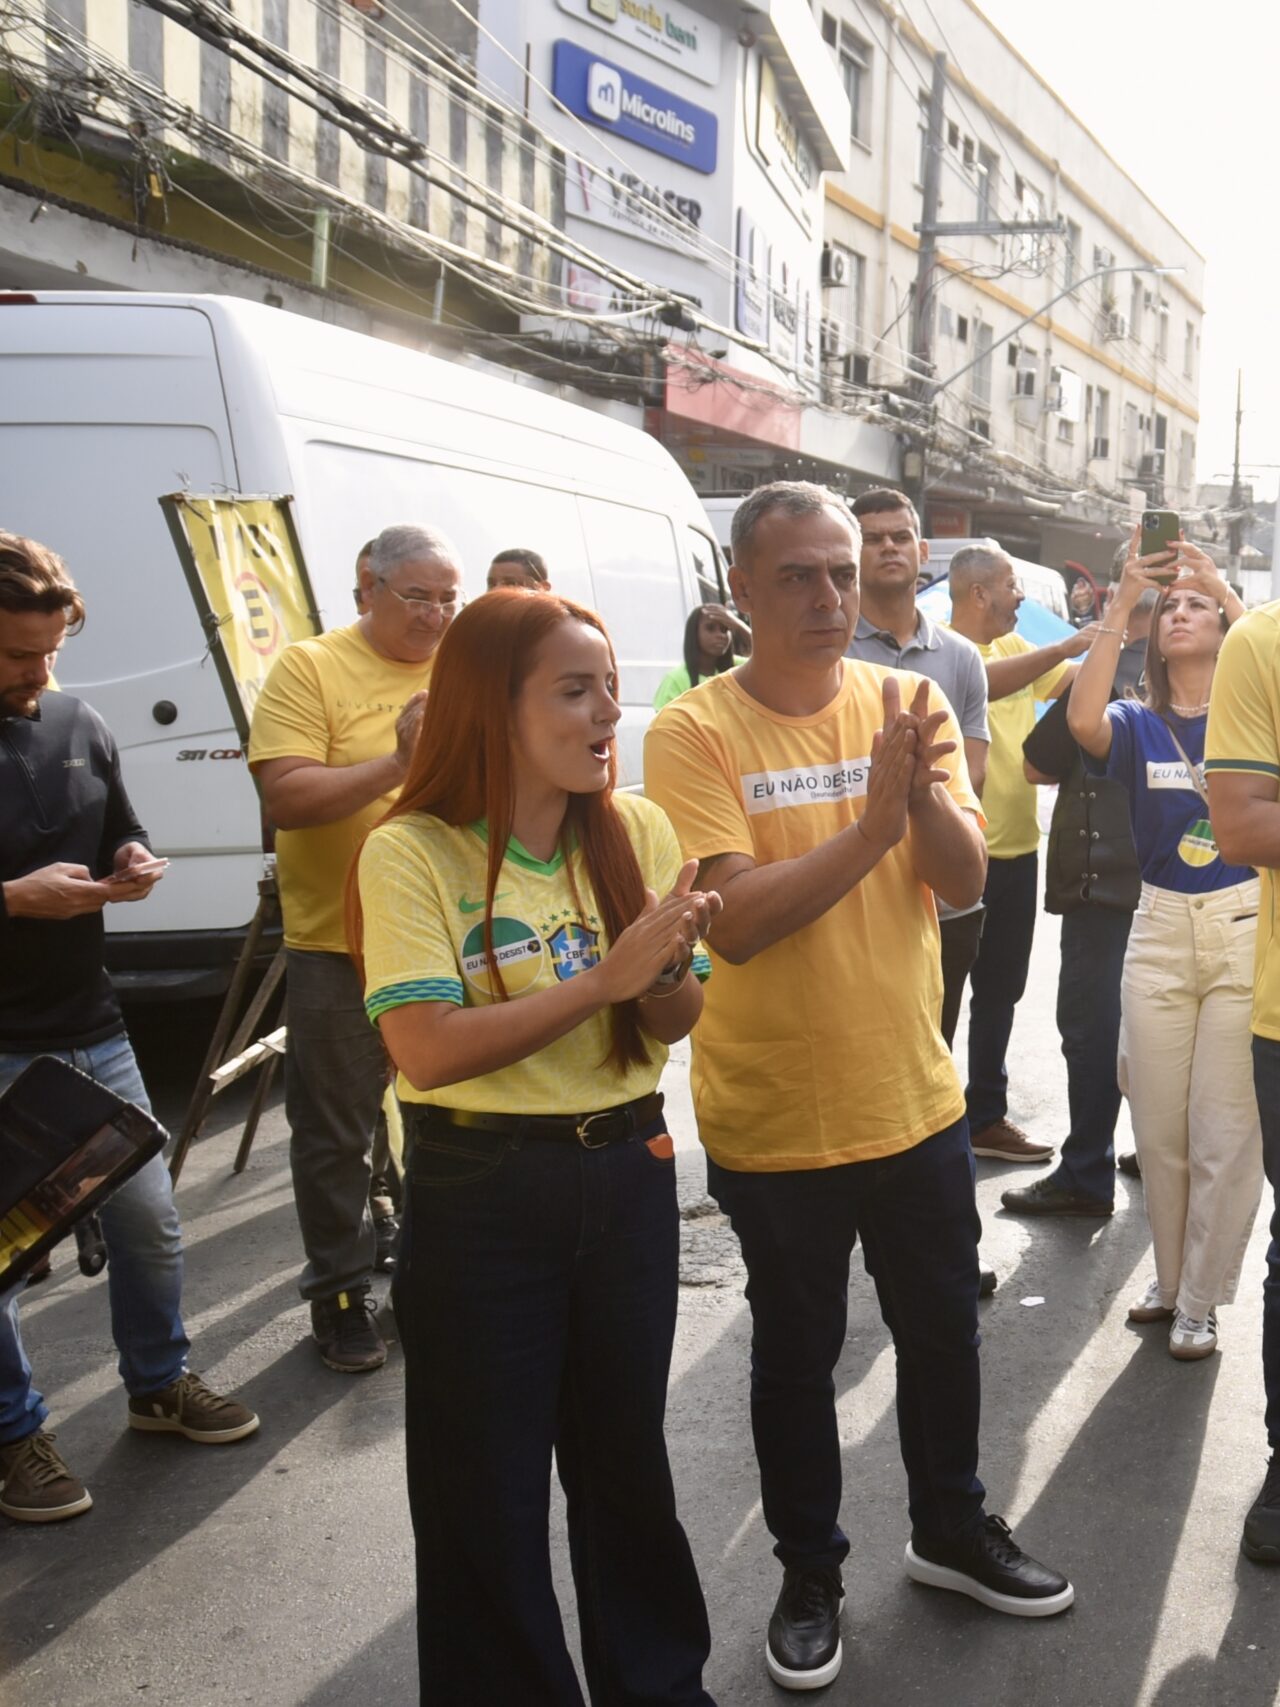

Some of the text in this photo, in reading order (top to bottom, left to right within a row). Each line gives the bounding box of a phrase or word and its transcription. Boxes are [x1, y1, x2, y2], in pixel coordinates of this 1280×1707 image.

[621, 88, 696, 143] Microlins
[1152, 768, 1171, 779] EU
[753, 782, 775, 798] EU
[781, 773, 818, 793] NÃO
[566, 949, 585, 960] CBF
[466, 960, 479, 971] EU
